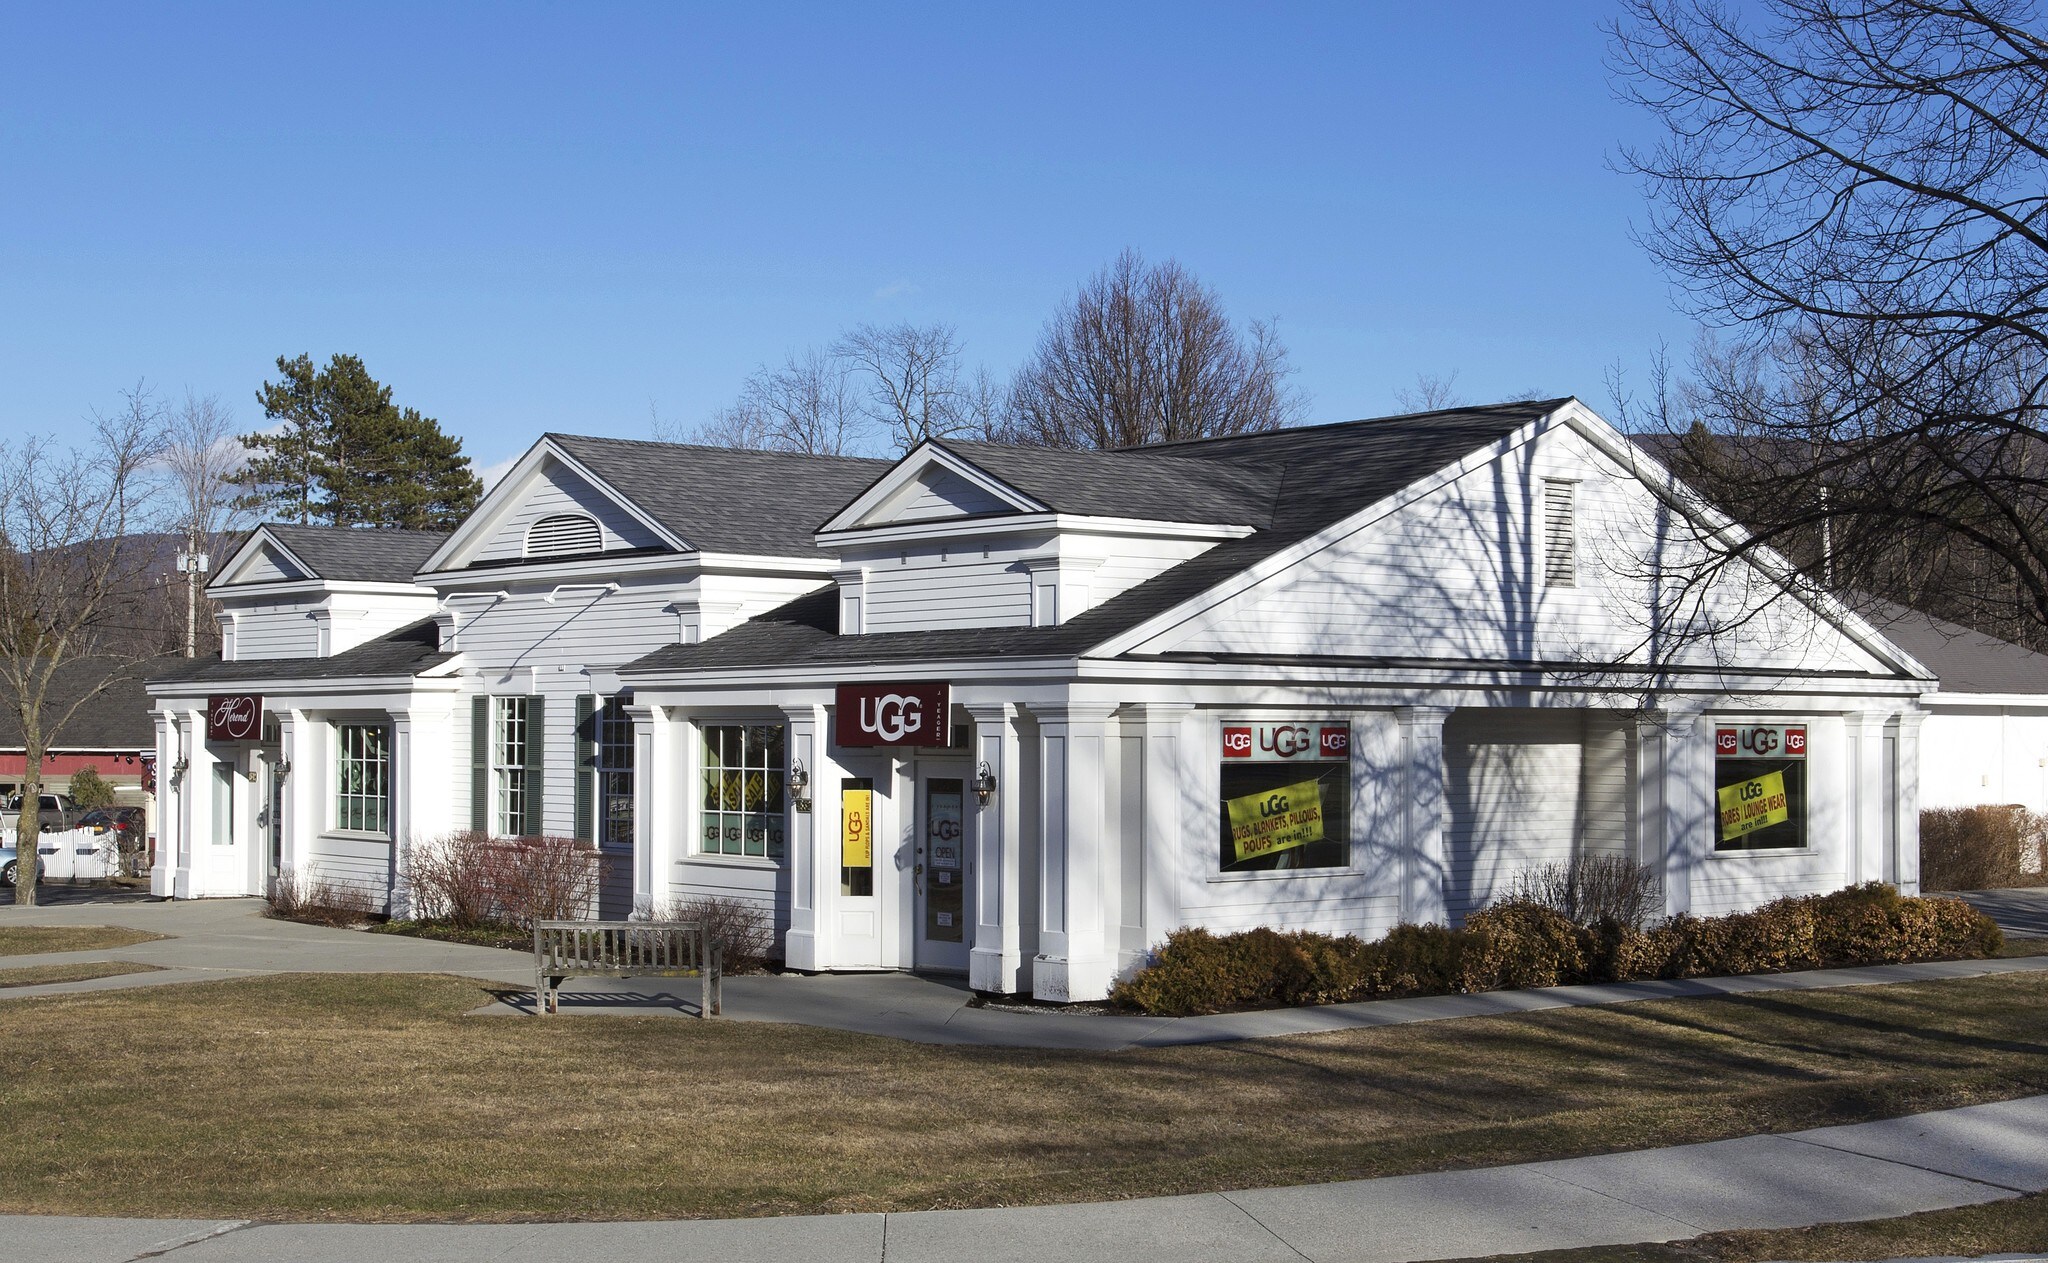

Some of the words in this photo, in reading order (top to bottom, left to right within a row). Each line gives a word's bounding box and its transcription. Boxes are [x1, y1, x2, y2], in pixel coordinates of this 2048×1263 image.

[214, 697, 256, 738] Herend
[860, 693, 922, 742] UGG
[1225, 733, 1251, 750] UGG
[1259, 725, 1311, 758] UGG
[1322, 733, 1347, 750] UGG
[1717, 734, 1737, 749] UGG
[1742, 727, 1778, 755] UGG
[1786, 734, 1805, 749] UGG
[1740, 781, 1763, 801] UGG
[1260, 794, 1290, 817] UGG
[1744, 798, 1767, 819] LOUNGE
[1767, 793, 1785, 811] WEAR
[848, 811, 863, 842] UGG
[932, 820, 960, 841] UGG
[1254, 815, 1289, 835] BLANKETS,
[1290, 807, 1320, 827] PILLOWS,
[1741, 821, 1753, 830] are
[724, 827, 742, 841] UGG
[746, 827, 764, 842] UGG
[1243, 835, 1272, 854] POUFS
[1276, 833, 1292, 845] are
[1293, 826, 1313, 841] in!!!
[935, 846, 955, 859] OPEN
